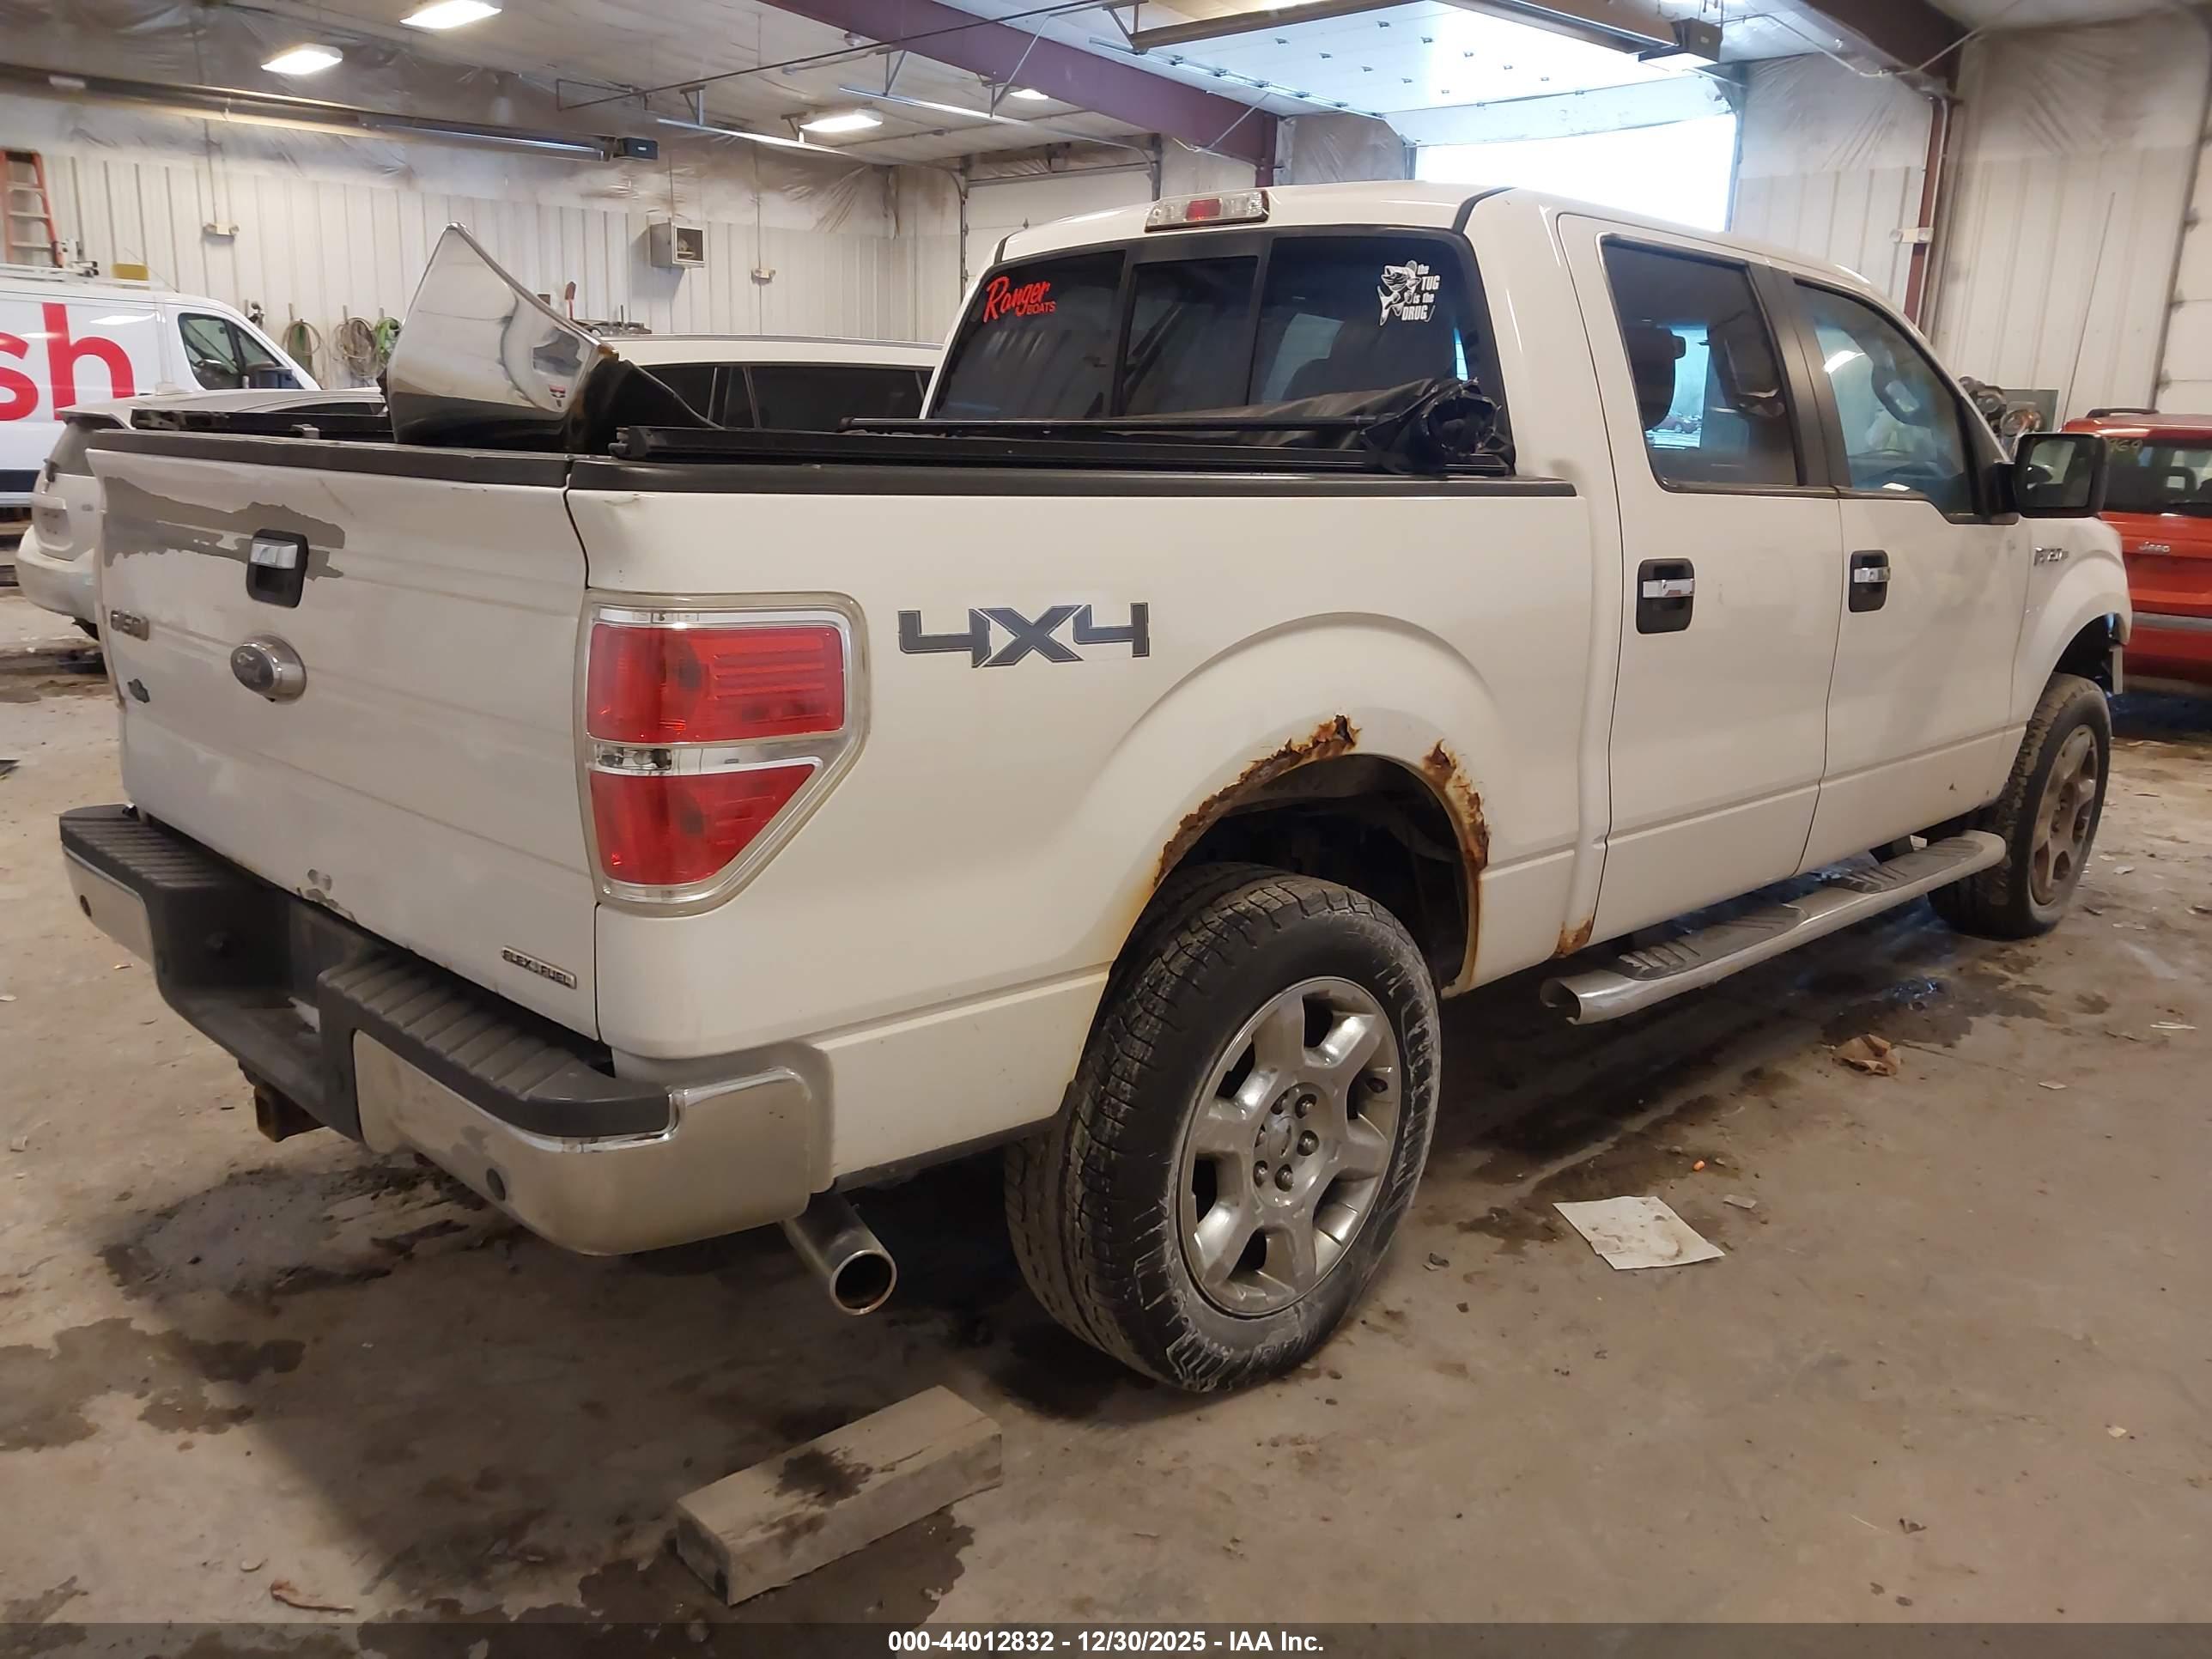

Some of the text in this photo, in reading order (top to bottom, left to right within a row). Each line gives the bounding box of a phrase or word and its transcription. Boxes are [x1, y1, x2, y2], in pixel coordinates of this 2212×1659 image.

[1421, 275, 1441, 291] TUG
[983, 276, 1051, 323] Ranger
[1026, 301, 1057, 315] BOATS
[1401, 305, 1429, 320] DRUG
[2138, 540, 2171, 556] Jeep
